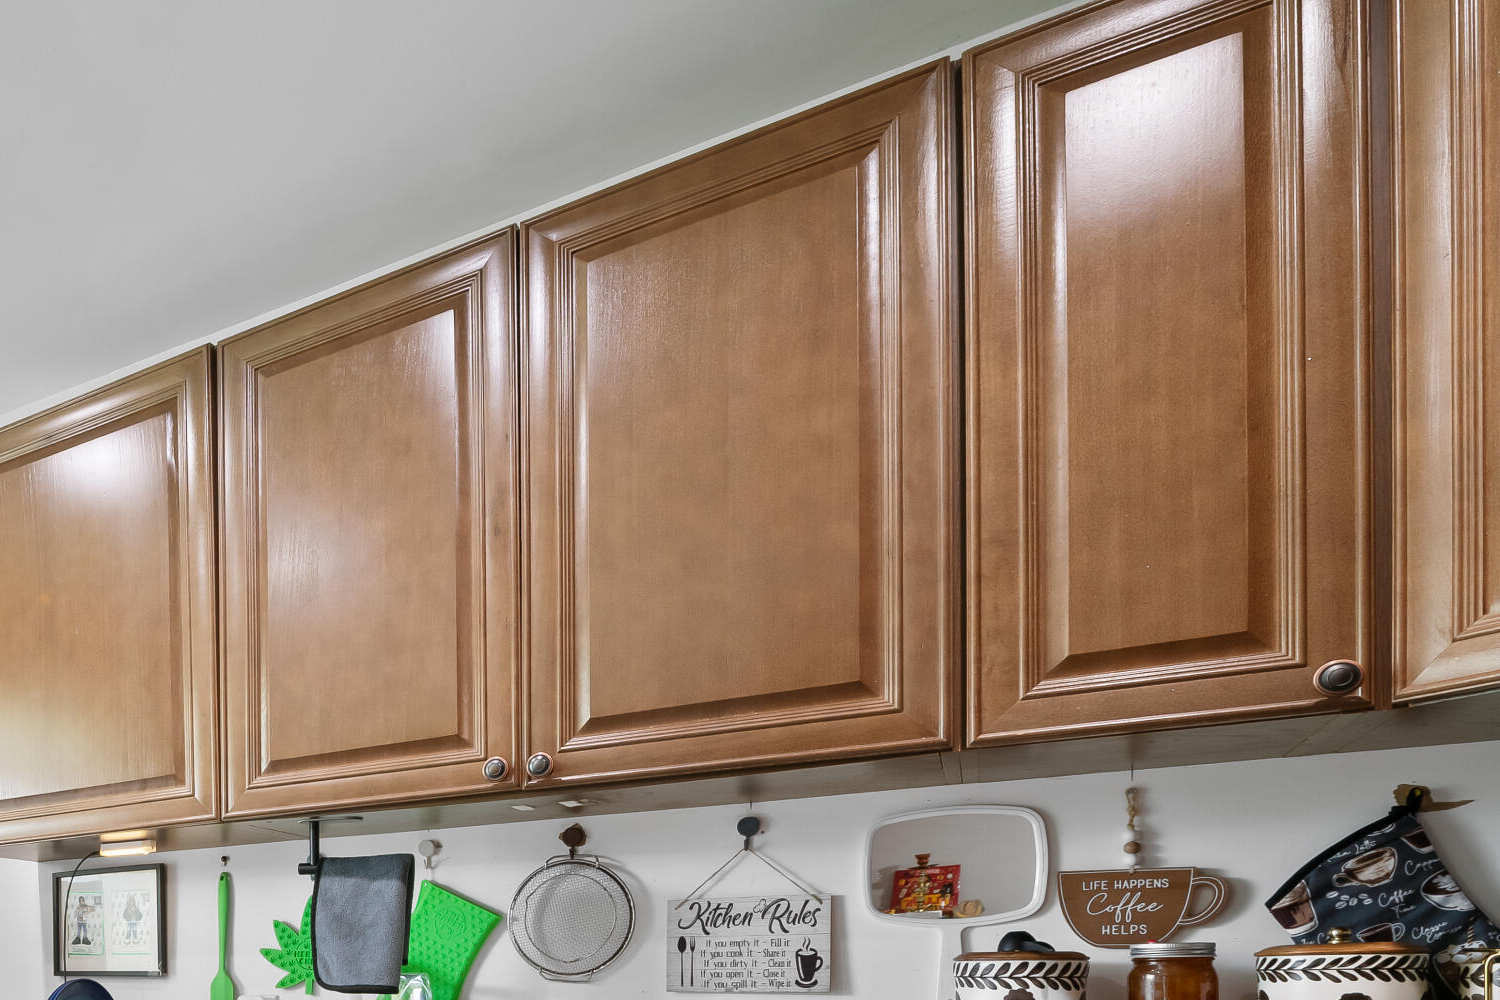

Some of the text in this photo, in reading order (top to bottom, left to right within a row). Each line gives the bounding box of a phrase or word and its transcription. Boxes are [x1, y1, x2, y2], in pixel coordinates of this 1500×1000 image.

[1082, 878, 1170, 891] LIFE HAPPENS
[1086, 891, 1164, 924] Coffee
[677, 898, 822, 936] Kitchen Rules
[1101, 924, 1148, 935] HELPS
[705, 939, 711, 947] If
[714, 941, 726, 950] you
[729, 940, 750, 949] empty
[753, 938, 759, 947] it
[770, 938, 782, 947] Fill
[784, 938, 789, 947] it
[710, 951, 723, 960] you
[726, 949, 743, 957] cook
[747, 949, 752, 957] it
[763, 948, 779, 957] Share
[781, 948, 786, 957] it
[703, 960, 709, 968] If
[713, 961, 726, 970] you
[730, 959, 748, 970] dirty
[752, 959, 757, 967] it
[768, 959, 785, 968] Clean
[786, 959, 791, 968] it
[700, 970, 706, 978] If
[710, 971, 723, 980] you
[726, 971, 744, 980] open
[747, 970, 752, 978] it
[763, 969, 779, 978] Close
[781, 969, 785, 978] it
[703, 980, 709, 988] If
[713, 981, 727, 991] you
[731, 980, 747, 990] spill
[751, 980, 757, 988] it
[768, 979, 785, 989] Wipe
[786, 979, 791, 987] it
